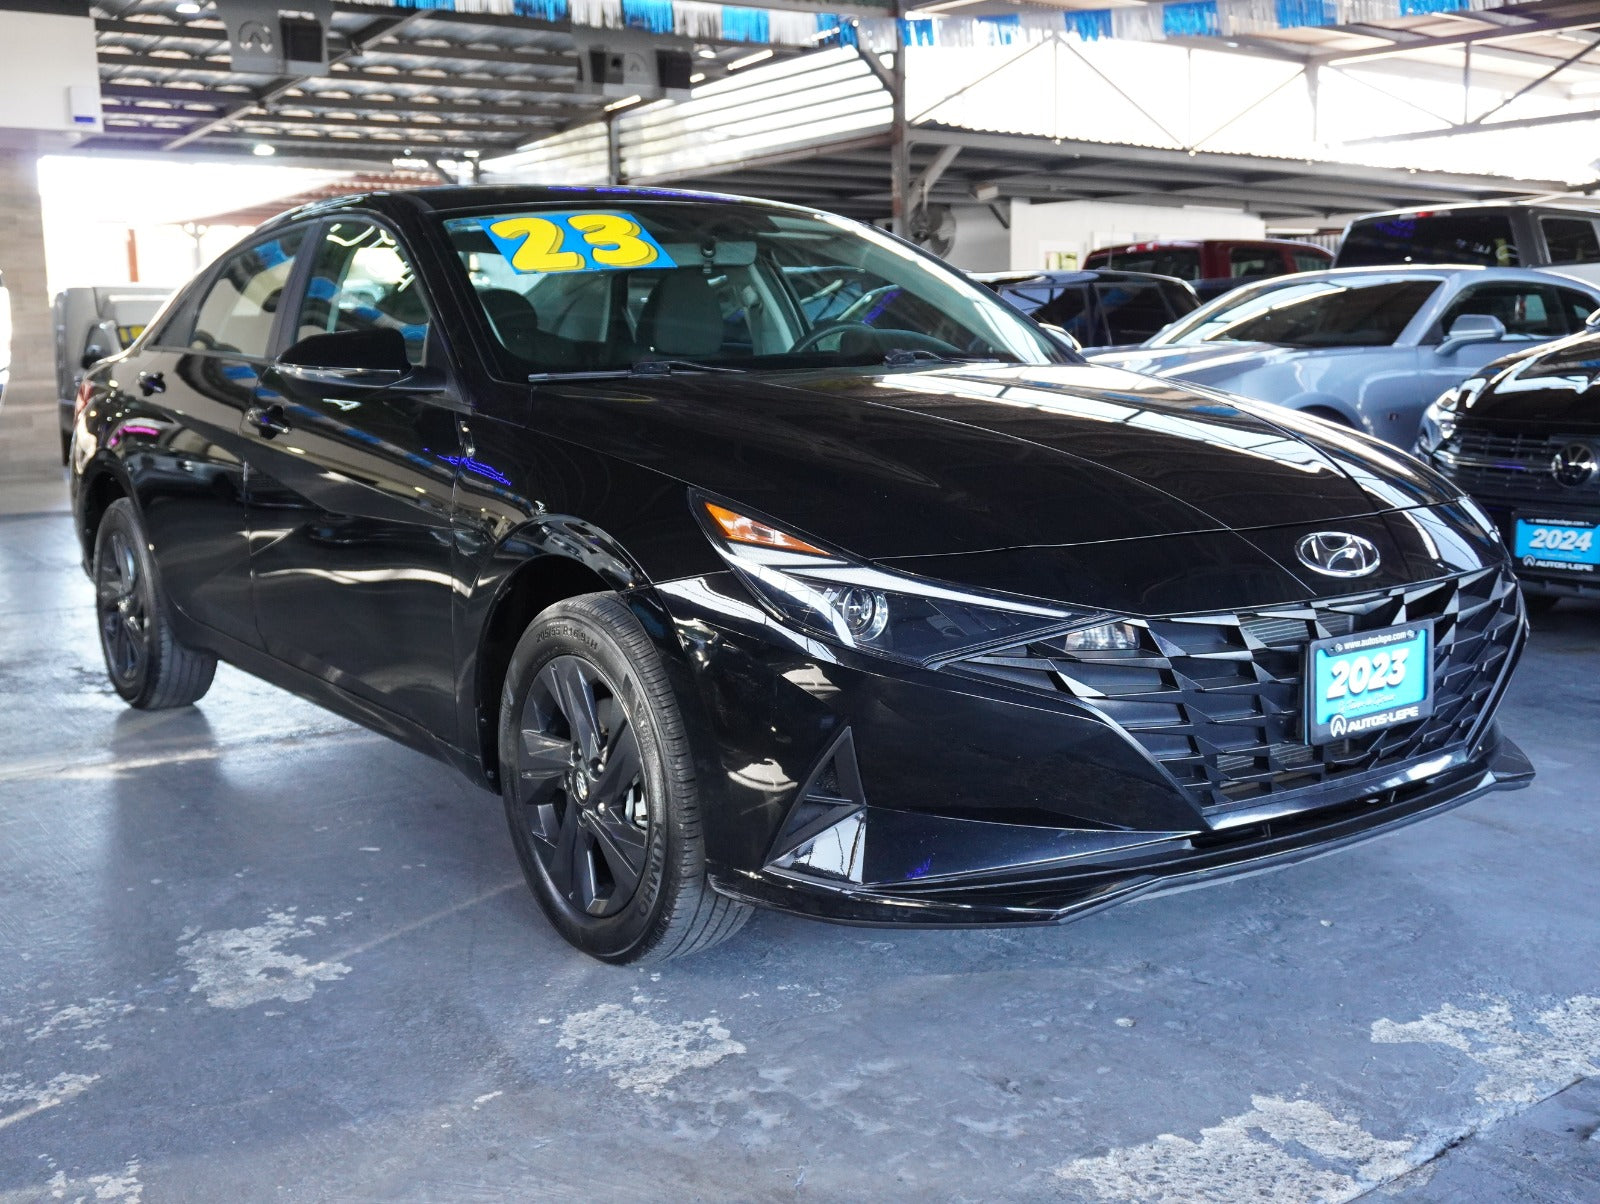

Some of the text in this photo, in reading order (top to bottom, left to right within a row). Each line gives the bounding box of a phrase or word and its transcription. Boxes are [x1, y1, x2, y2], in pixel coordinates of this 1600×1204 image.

[489, 213, 659, 273] 23
[1529, 528, 1593, 552] 2024
[1326, 647, 1410, 701] 2023
